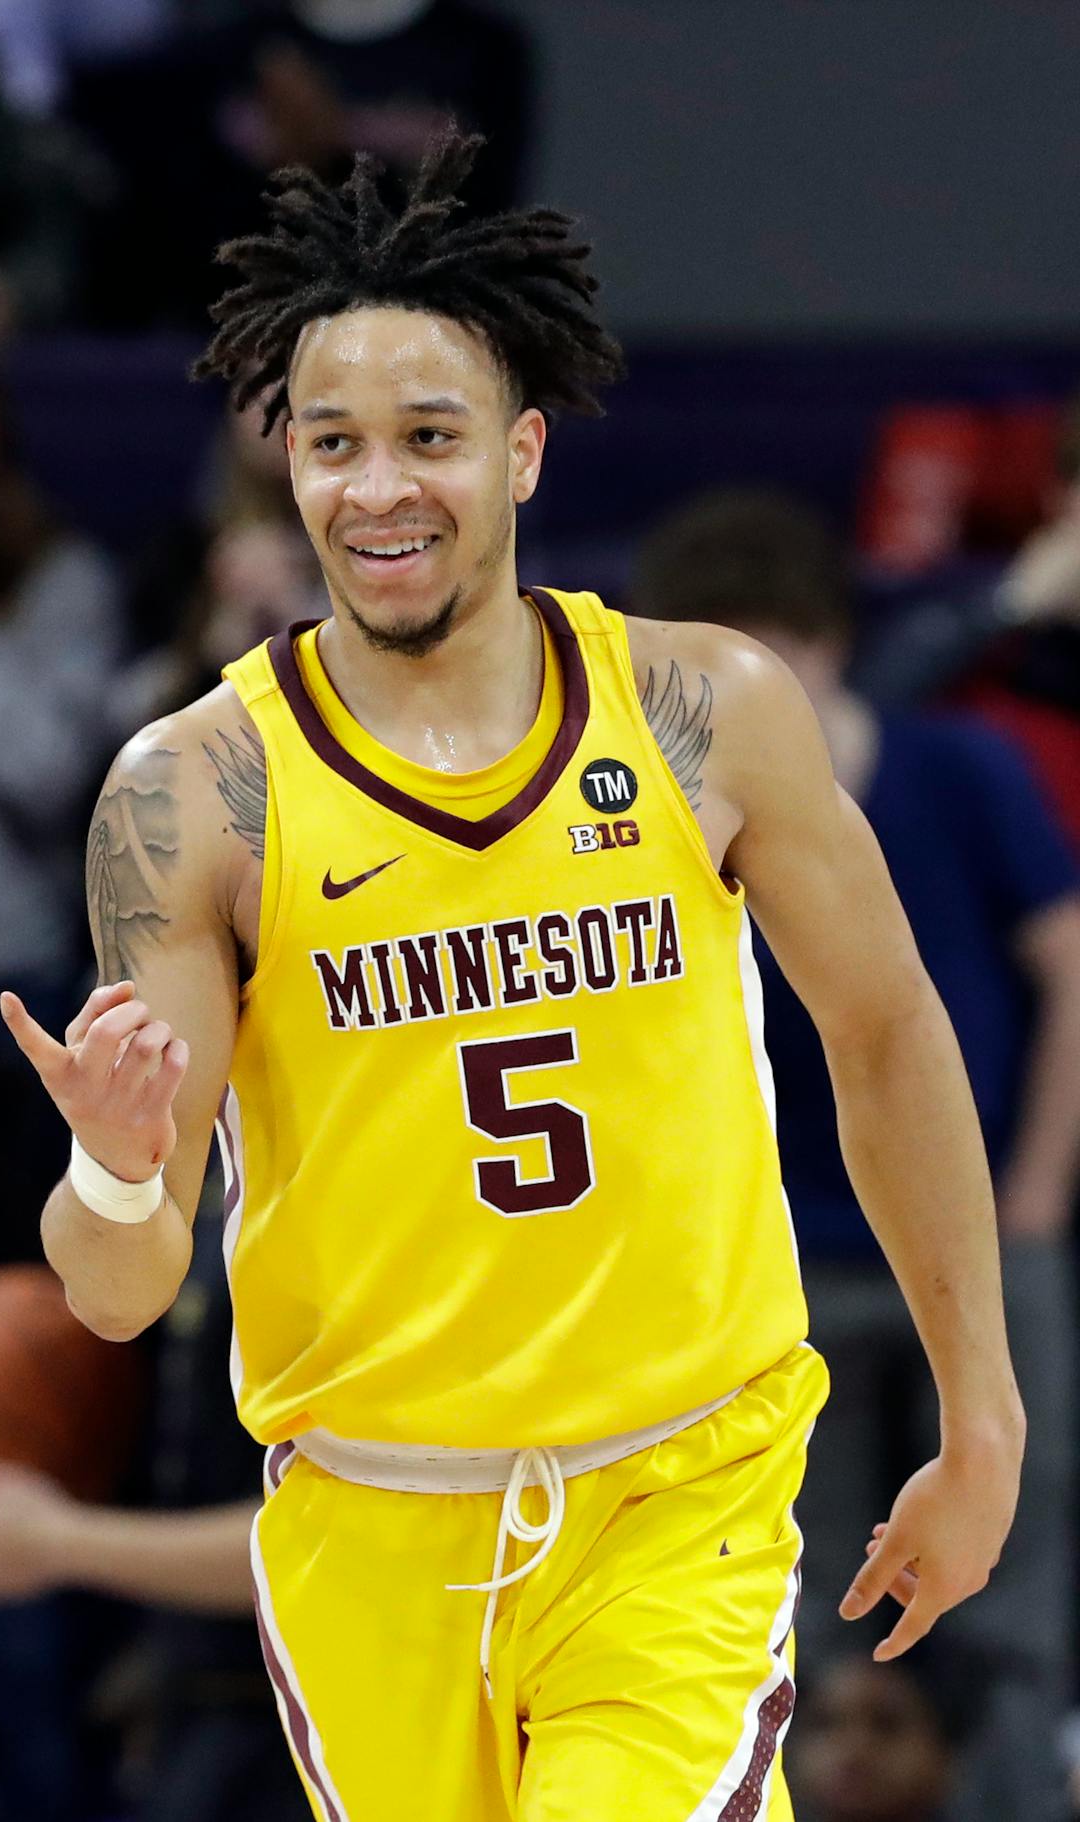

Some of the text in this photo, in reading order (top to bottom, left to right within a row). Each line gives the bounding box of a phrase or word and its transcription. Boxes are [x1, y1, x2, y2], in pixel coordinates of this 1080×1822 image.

[586, 770, 631, 803] TM
[310, 893, 684, 1031] MINNESOTA
[456, 1027, 596, 1217] 5
